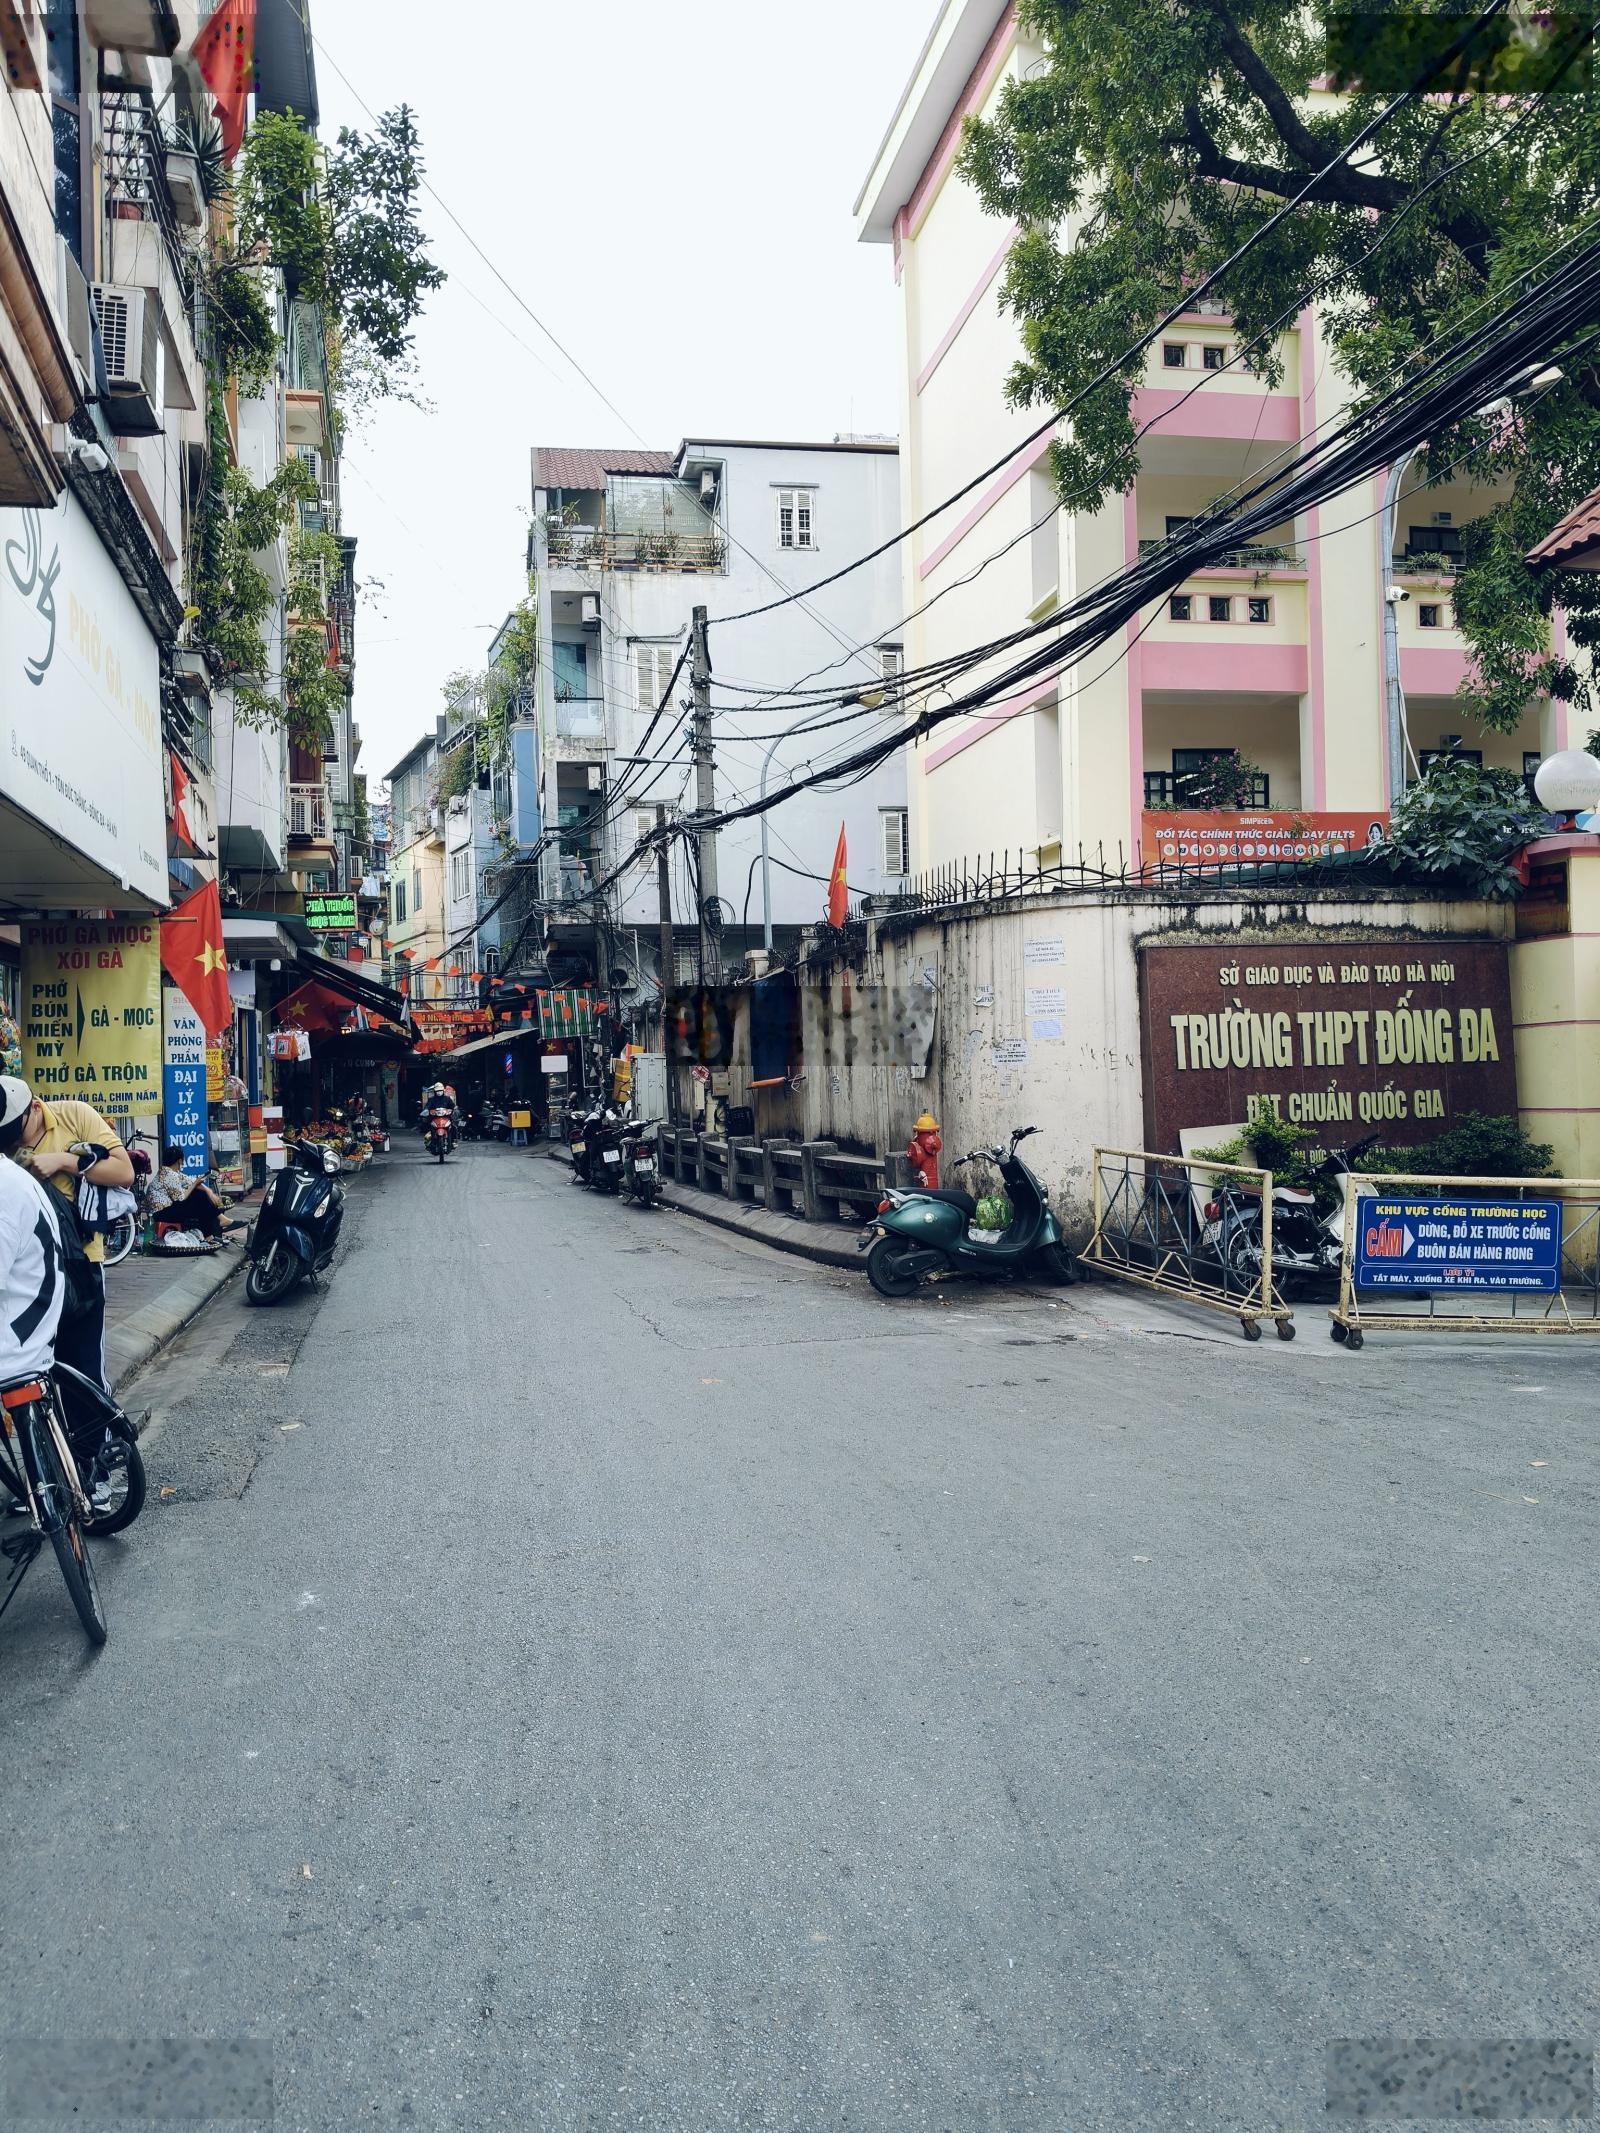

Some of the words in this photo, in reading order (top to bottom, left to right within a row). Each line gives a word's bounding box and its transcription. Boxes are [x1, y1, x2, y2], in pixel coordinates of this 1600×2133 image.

[1156, 828, 1175, 839] ĐỐI
[1178, 828, 1198, 839] TÁC
[1200, 828, 1232, 839] CHÍNH
[1235, 828, 1262, 839] THỨC
[1302, 831, 1324, 841] DẠY
[1326, 831, 1355, 839] IELTS
[326, 896, 353, 912] THUỐC
[75, 923, 100, 944] GÀ
[107, 925, 152, 947] MỌC
[57, 948, 90, 969] XÔI
[98, 948, 123, 968] GÀ
[1219, 960, 1240, 986] SỞ
[1246, 962, 1278, 984] GIÁO
[1283, 965, 1312, 989] DỤC
[1318, 960, 1335, 984] VÀ
[1340, 960, 1370, 983] ĐÀO
[1375, 964, 1401, 988] TẠO
[1406, 960, 1425, 982] HÀ
[1430, 959, 1455, 986] NỘI
[32, 978, 68, 998] PHỞ
[32, 1001, 68, 1017] BÚN
[91, 1005, 109, 1026] GÀ
[124, 1008, 154, 1029] MỌC
[27, 1019, 72, 1037] MIẾN
[173, 1018, 196, 1029] VĂN
[1170, 998, 1292, 1070] TRƯỜNG
[1297, 1010, 1370, 1066] THPT
[1375, 990, 1452, 1065] ĐỐNG
[1459, 1008, 1499, 1063] ĐA
[37, 1040, 64, 1056] MỲ
[168, 1034, 202, 1046] PHÒNG
[34, 1062, 70, 1083] PHỞ
[75, 1063, 96, 1082] GÀ
[102, 1062, 148, 1084] TRỘN
[174, 1070, 197, 1086] ĐẠI
[110, 1092, 133, 1102] CHIM
[178, 1089, 194, 1104] LÝ
[1288, 1079, 1352, 1121] CHUẨN
[1359, 1080, 1407, 1123] QUỐC
[1414, 1089, 1444, 1118] GIA
[175, 1108, 199, 1125] CẤP
[170, 1131, 204, 1147] NƯỚC
[1376, 1205, 1402, 1215] KHU
[1405, 1206, 1429, 1218] VỰC
[1432, 1204, 1467, 1216] CỔNG
[1470, 1205, 1519, 1217] TRƯỜNG
[1522, 1209, 1547, 1220] HỌC
[1366, 1218, 1403, 1257] CẤM
[1418, 1221, 1451, 1240] DỪNG,
[1453, 1220, 1468, 1239] ĐỖ
[1470, 1226, 1484, 1239] XE
[1486, 1222, 1520, 1240] TRƯỚC
[1522, 1222, 1550, 1240] CỔNG
[1417, 1243, 1446, 1258] BUÔN
[1449, 1243, 1471, 1259] BÁN
[1474, 1243, 1502, 1260] HÀNG
[1505, 1247, 1533, 1260] RONG
[1414, 1274, 1442, 1283] XUỐNG
[1490, 1275, 1506, 1284] VÀO
